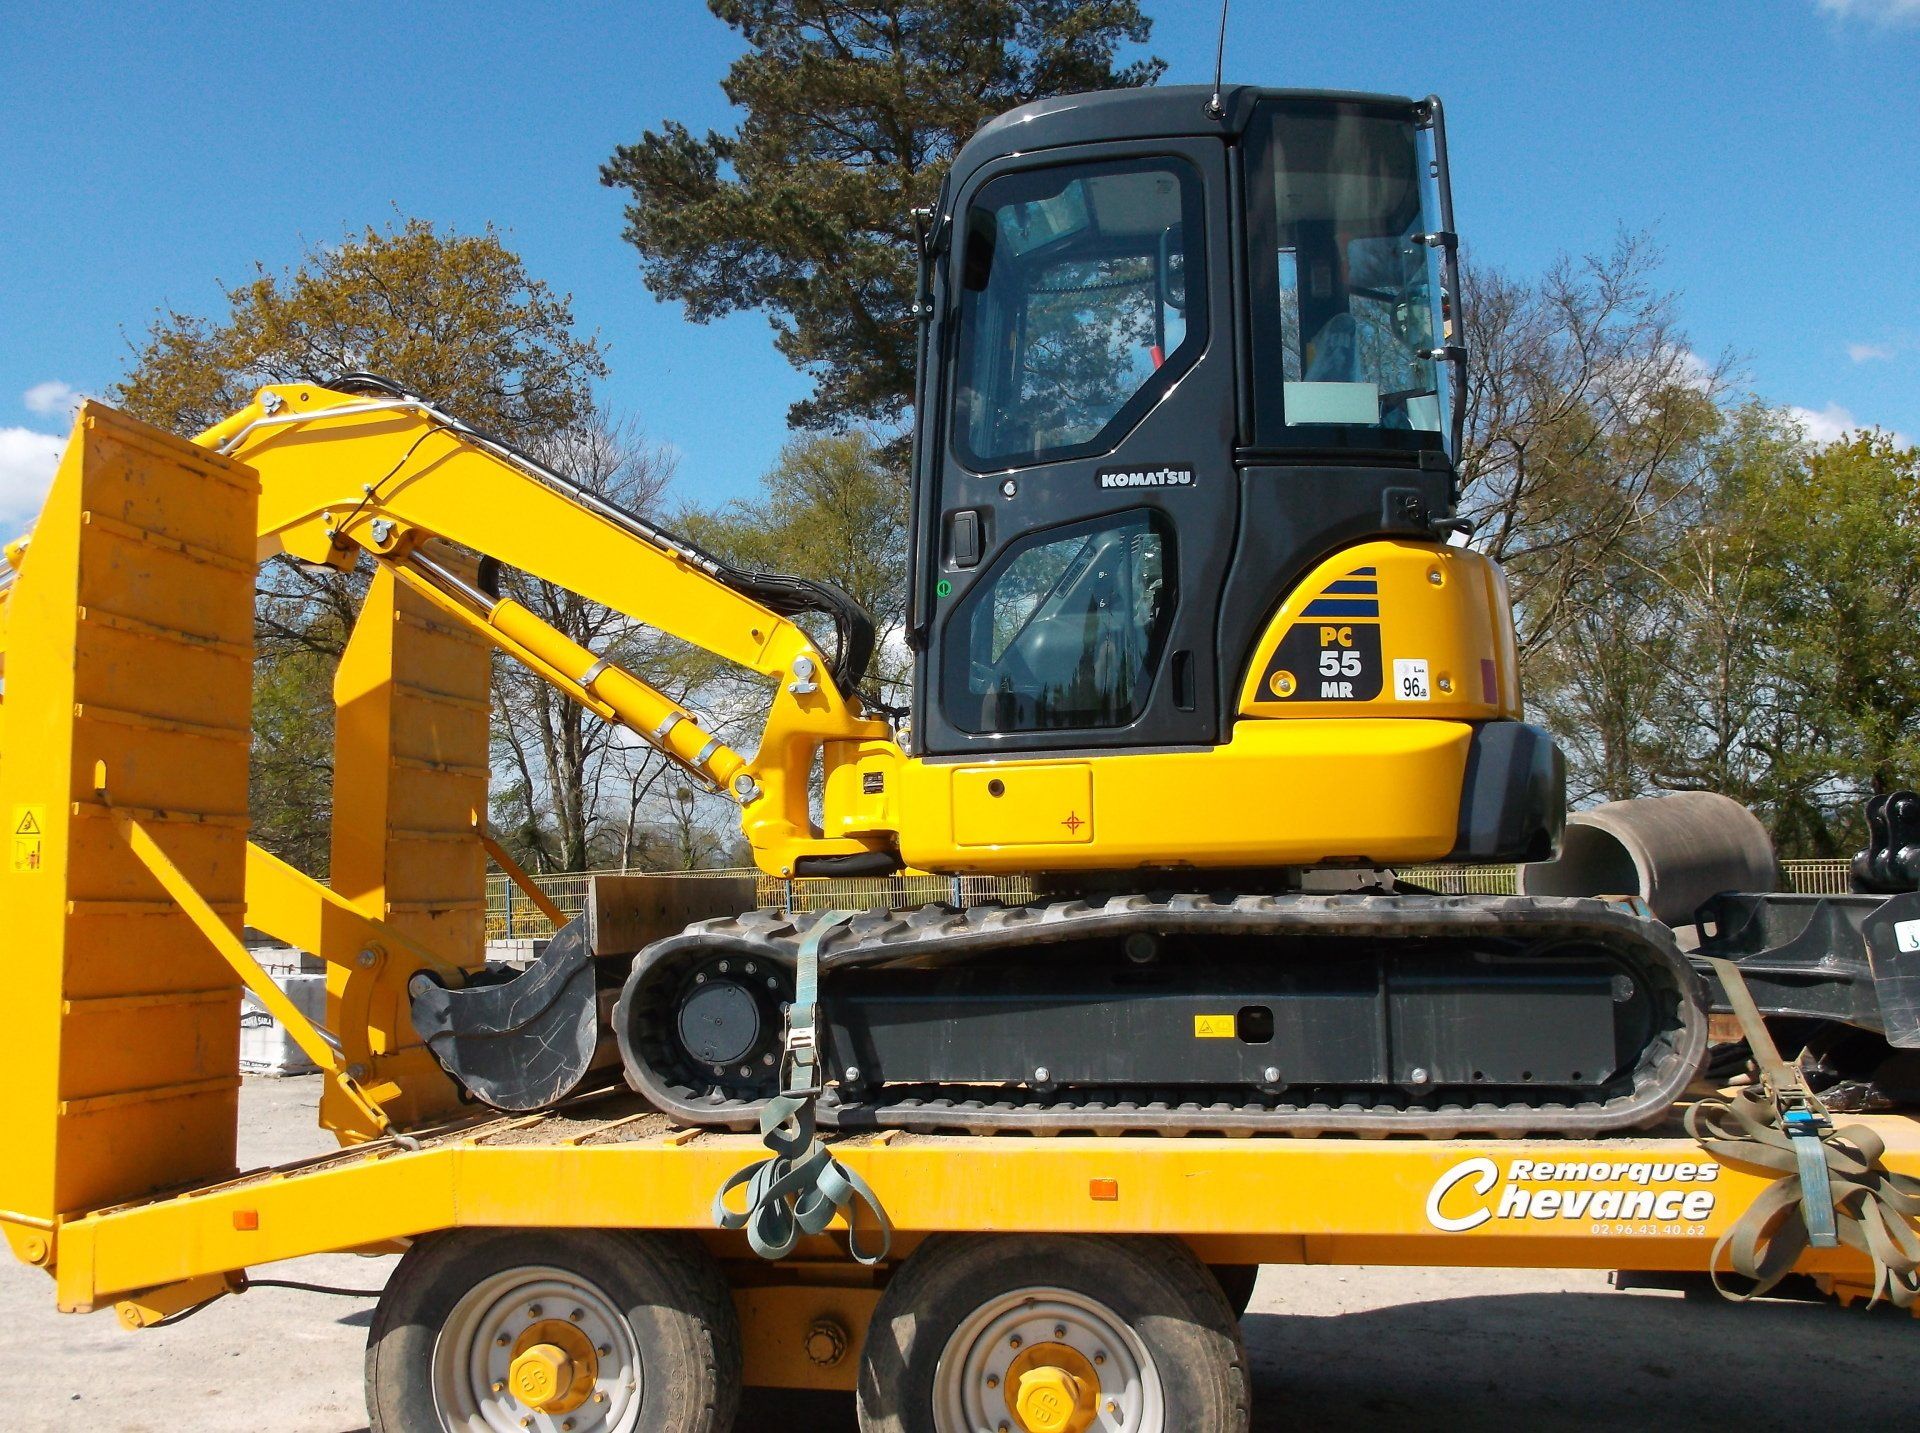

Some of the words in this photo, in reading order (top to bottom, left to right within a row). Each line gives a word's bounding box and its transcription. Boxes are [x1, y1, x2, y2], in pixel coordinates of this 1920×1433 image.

[1102, 468, 1191, 488] KOMATSU
[1320, 626, 1353, 647] PC
[1319, 651, 1362, 677] 55
[1321, 682, 1355, 698] MR
[1403, 677, 1420, 697] 96
[1507, 1159, 1720, 1185] Remorques
[1425, 1157, 1716, 1232] Chevance
[1592, 1224, 1706, 1236] 02.96.43.40.62
